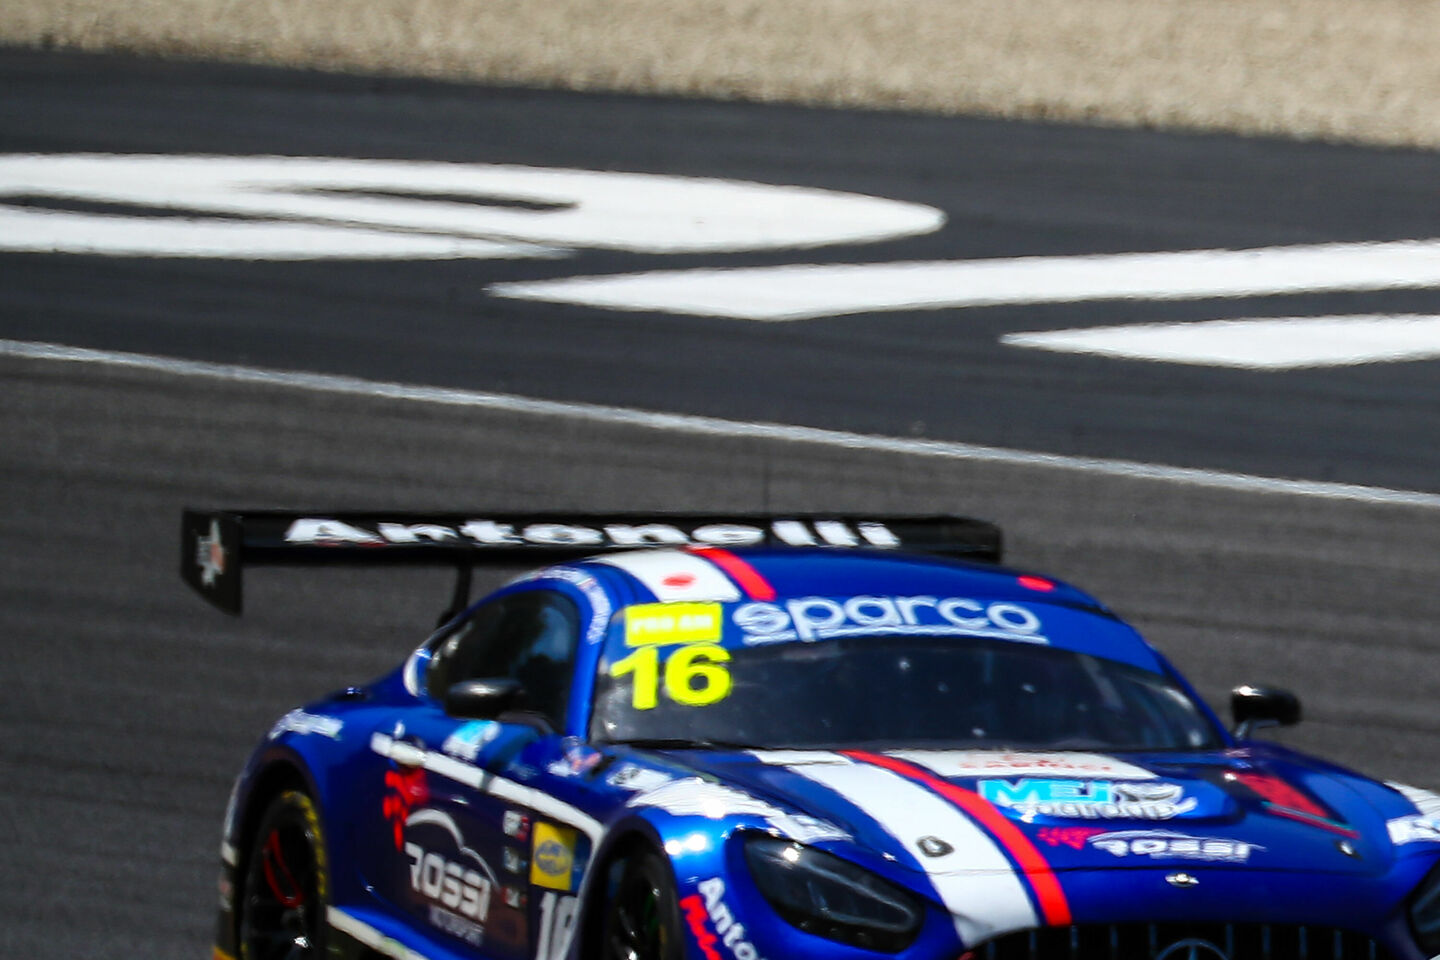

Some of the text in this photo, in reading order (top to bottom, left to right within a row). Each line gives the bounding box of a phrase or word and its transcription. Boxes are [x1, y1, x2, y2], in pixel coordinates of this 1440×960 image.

[284, 518, 900, 547] Antonelli
[732, 595, 1043, 645] sparco
[610, 642, 733, 710] 16
